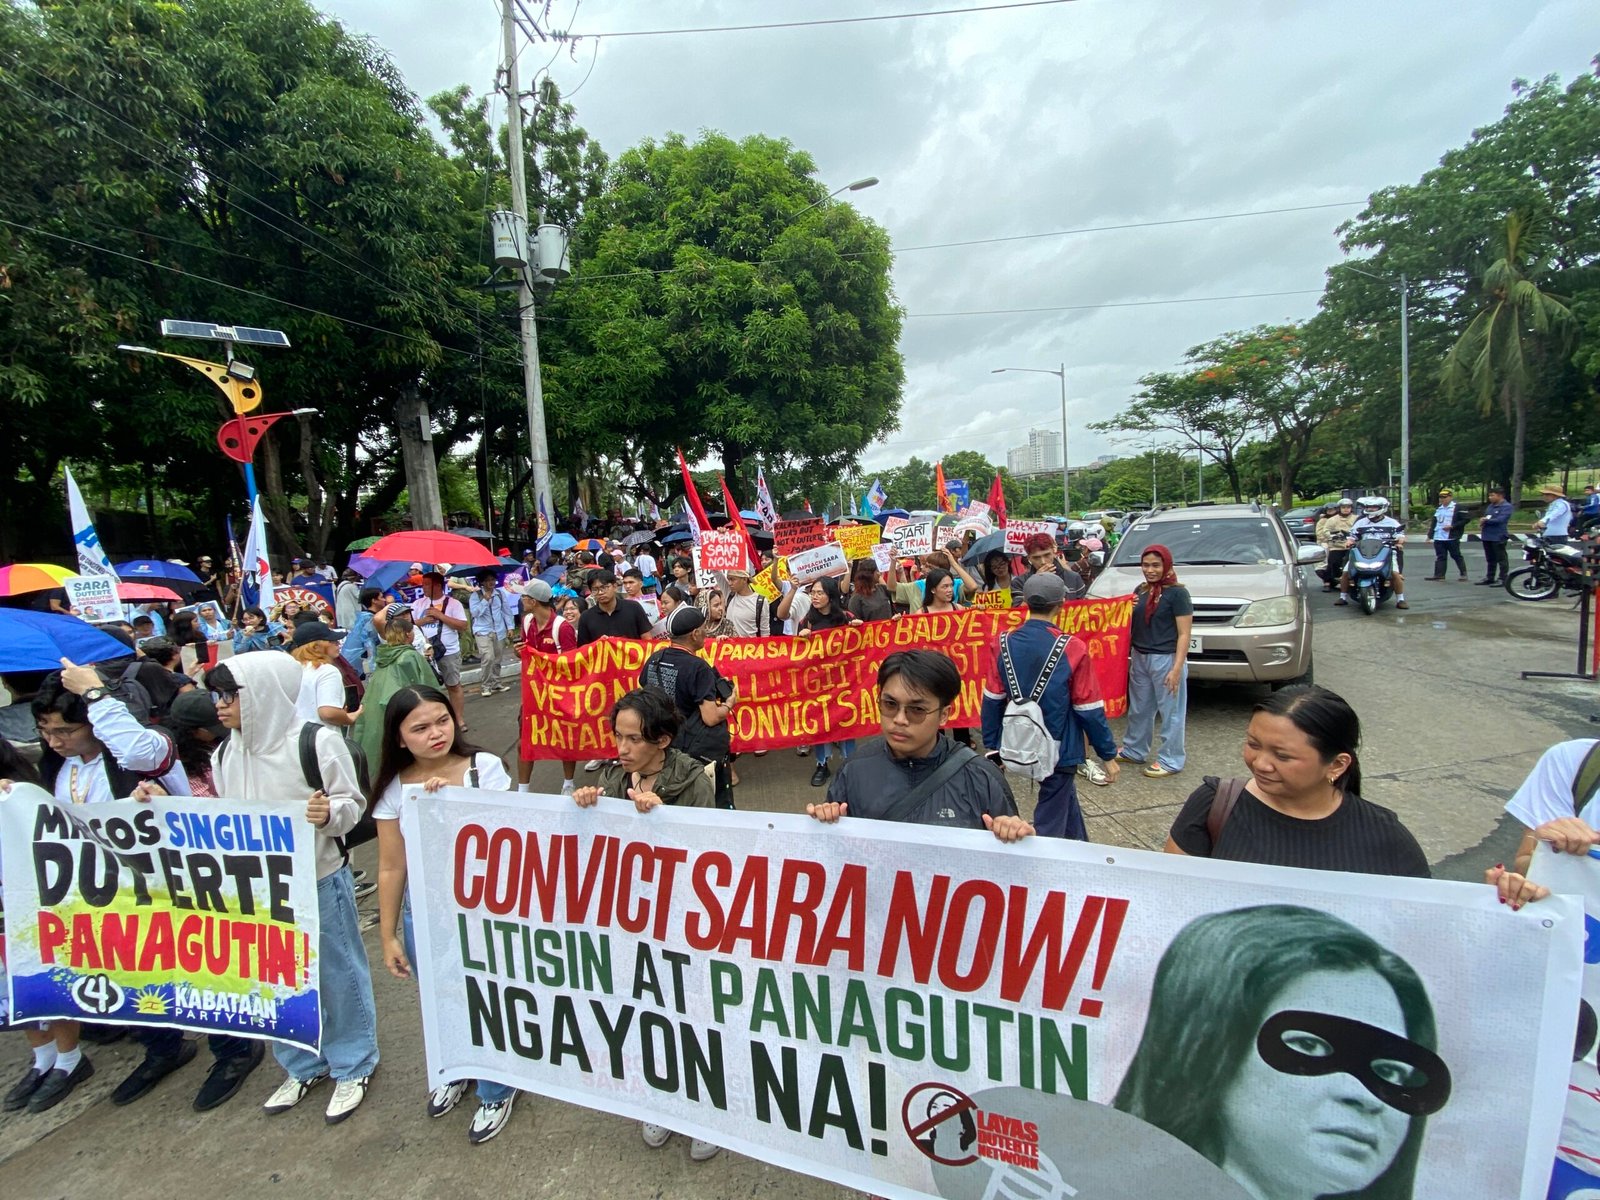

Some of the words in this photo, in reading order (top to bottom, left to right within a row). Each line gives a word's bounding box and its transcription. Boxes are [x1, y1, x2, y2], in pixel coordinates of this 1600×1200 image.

[894, 522, 930, 541] START
[905, 538, 931, 549] TRIAL
[708, 557, 739, 568] NOW!
[797, 560, 823, 571] IMPEACH
[824, 555, 838, 563] SARA
[74, 580, 110, 592] SARA
[75, 589, 112, 598] DUTERTE
[277, 588, 328, 612] NYOG
[718, 643, 765, 661] PARA
[767, 641, 788, 659] SA
[790, 620, 892, 662] DAGDAG
[894, 609, 1009, 646] BADYET
[1033, 676, 1049, 698] THAT
[1044, 655, 1059, 674] YOU
[1055, 637, 1068, 653] ARE
[530, 680, 607, 719] VETO
[165, 811, 295, 853] SINGILIN
[33, 841, 295, 924] DUTERTE
[453, 823, 688, 943] CONVICT
[684, 851, 867, 972] SARA
[877, 870, 1131, 1018] NOW!
[37, 910, 310, 988] PANAGUTIN!
[84, 975, 110, 1013] 4
[175, 986, 278, 1020] KABATAAN
[457, 912, 614, 995] LITISIN
[632, 941, 691, 1015] AT
[709, 959, 1089, 1101] PANAGUTIN
[175, 1007, 278, 1030] PARTYLIST
[465, 974, 728, 1110] NGAYON
[749, 1039, 888, 1157] NA!
[977, 1109, 1039, 1143] LAYAS
[978, 1129, 1039, 1157] DUTERTE
[978, 1144, 1040, 1171] NETWORK
